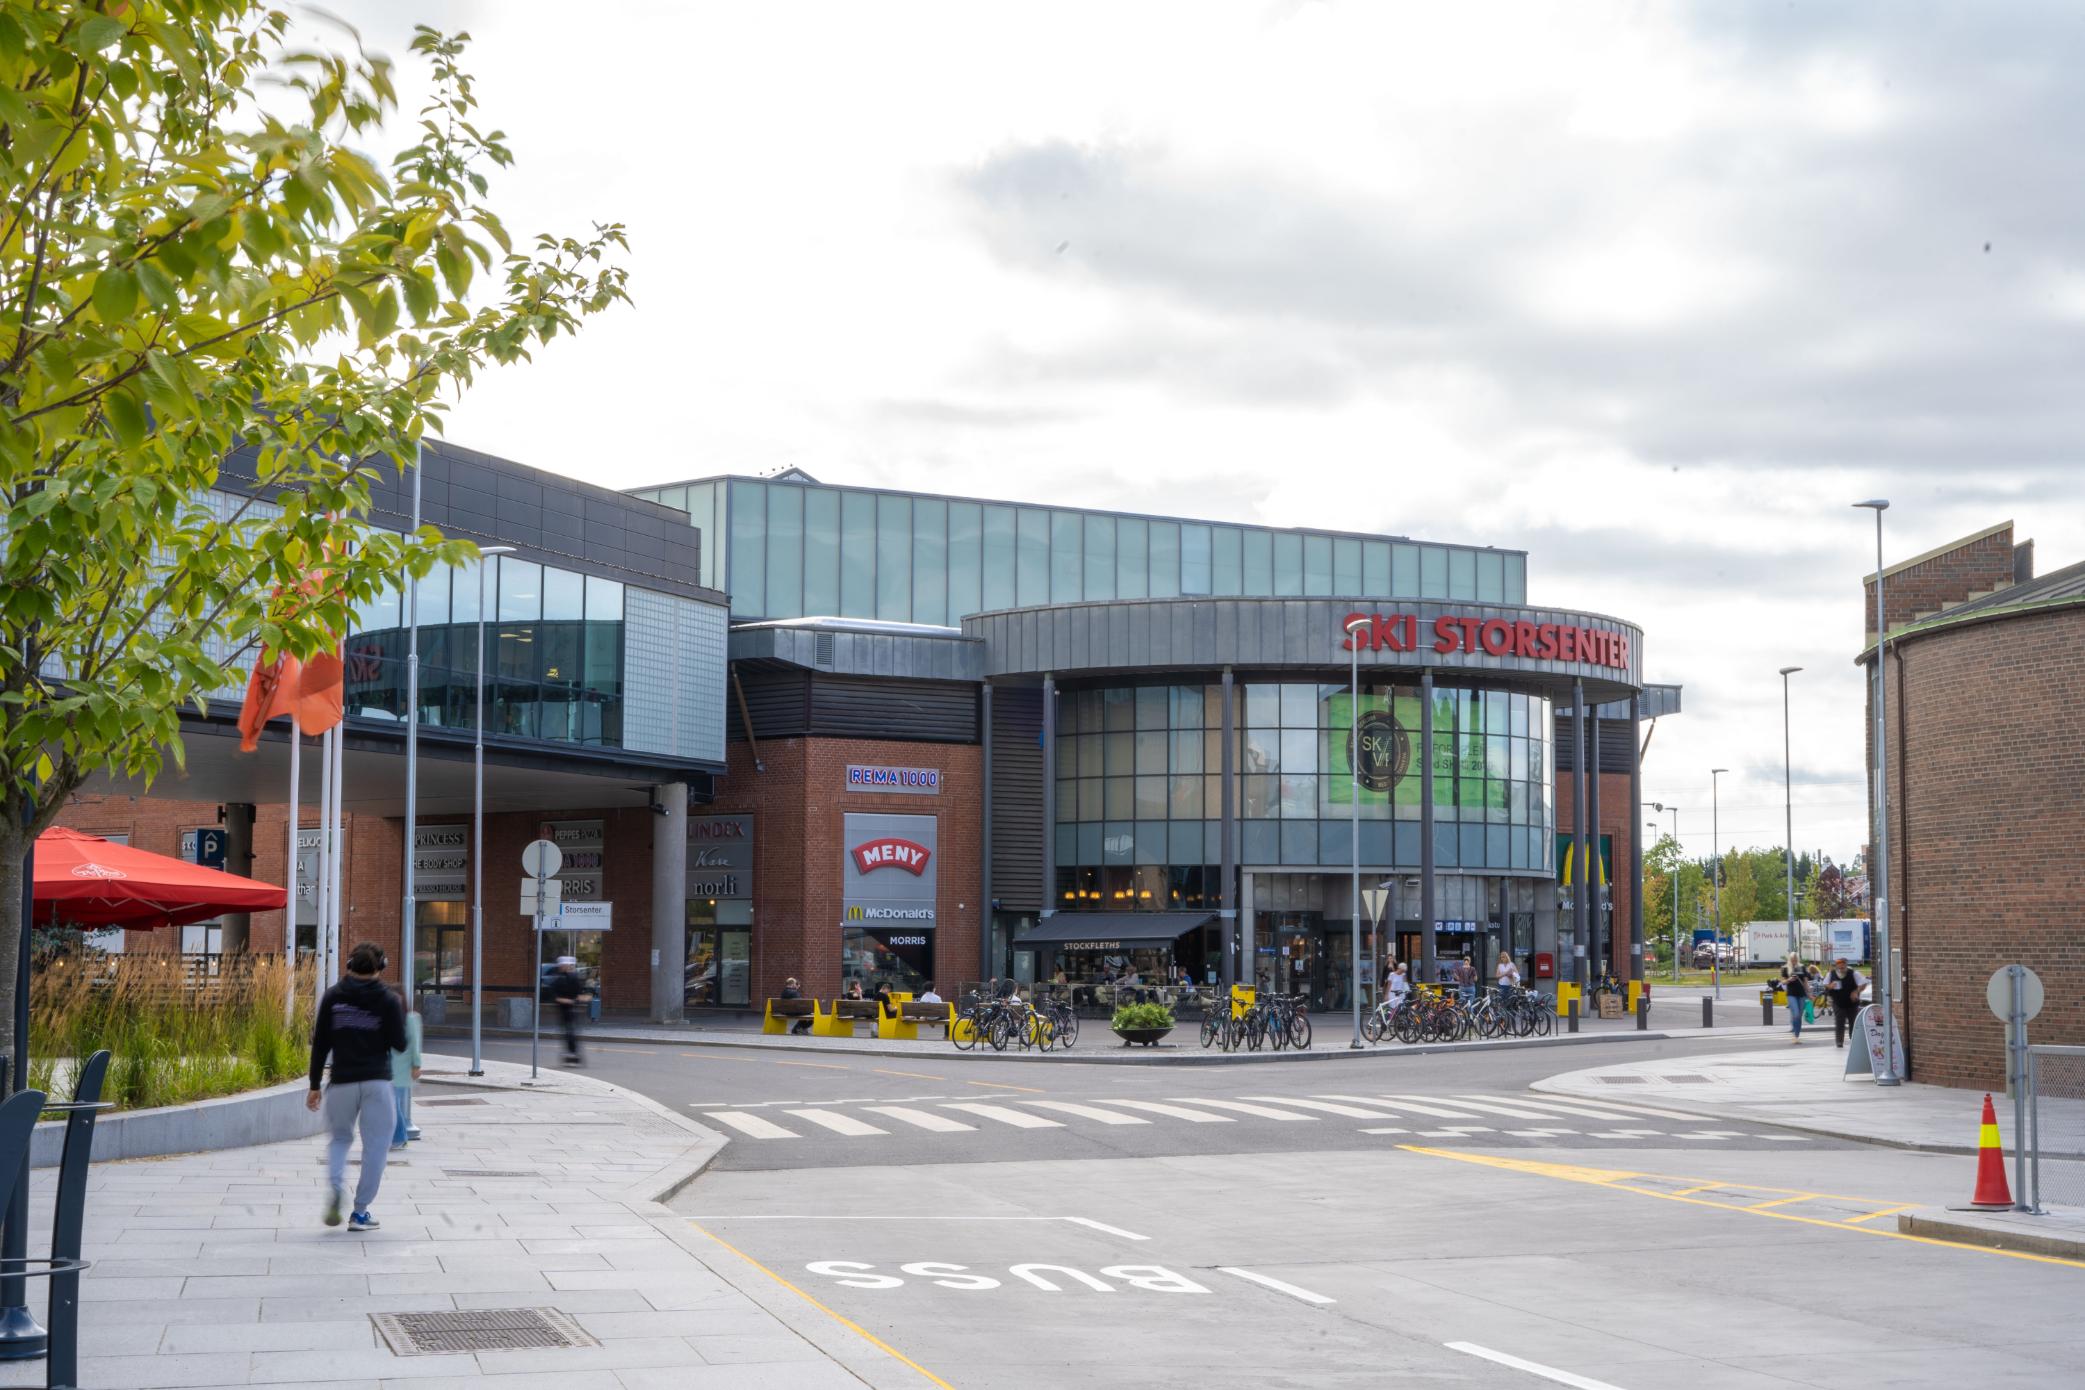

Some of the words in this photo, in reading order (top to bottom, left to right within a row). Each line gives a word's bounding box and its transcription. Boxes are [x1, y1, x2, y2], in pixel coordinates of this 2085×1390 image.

[1343, 613, 1417, 652] SKI
[1434, 615, 1629, 671] STORSENTER
[851, 768, 898, 784] REMA
[902, 771, 937, 786] 1000
[415, 832, 461, 846] PRINCESS
[687, 821, 744, 840] LINDEX
[204, 841, 218, 859] P
[862, 844, 924, 865] MENY
[423, 858, 443, 869] BODY
[443, 858, 463, 869] SHOP
[560, 879, 592, 895] RRIS
[694, 874, 736, 895] norli
[565, 905, 602, 914] Storsenter
[865, 907, 935, 919] McDonald's
[890, 936, 926, 945] MORRIS
[1063, 941, 1121, 951] STOCKFLETHS
[805, 1260, 1214, 1294] BUSS
